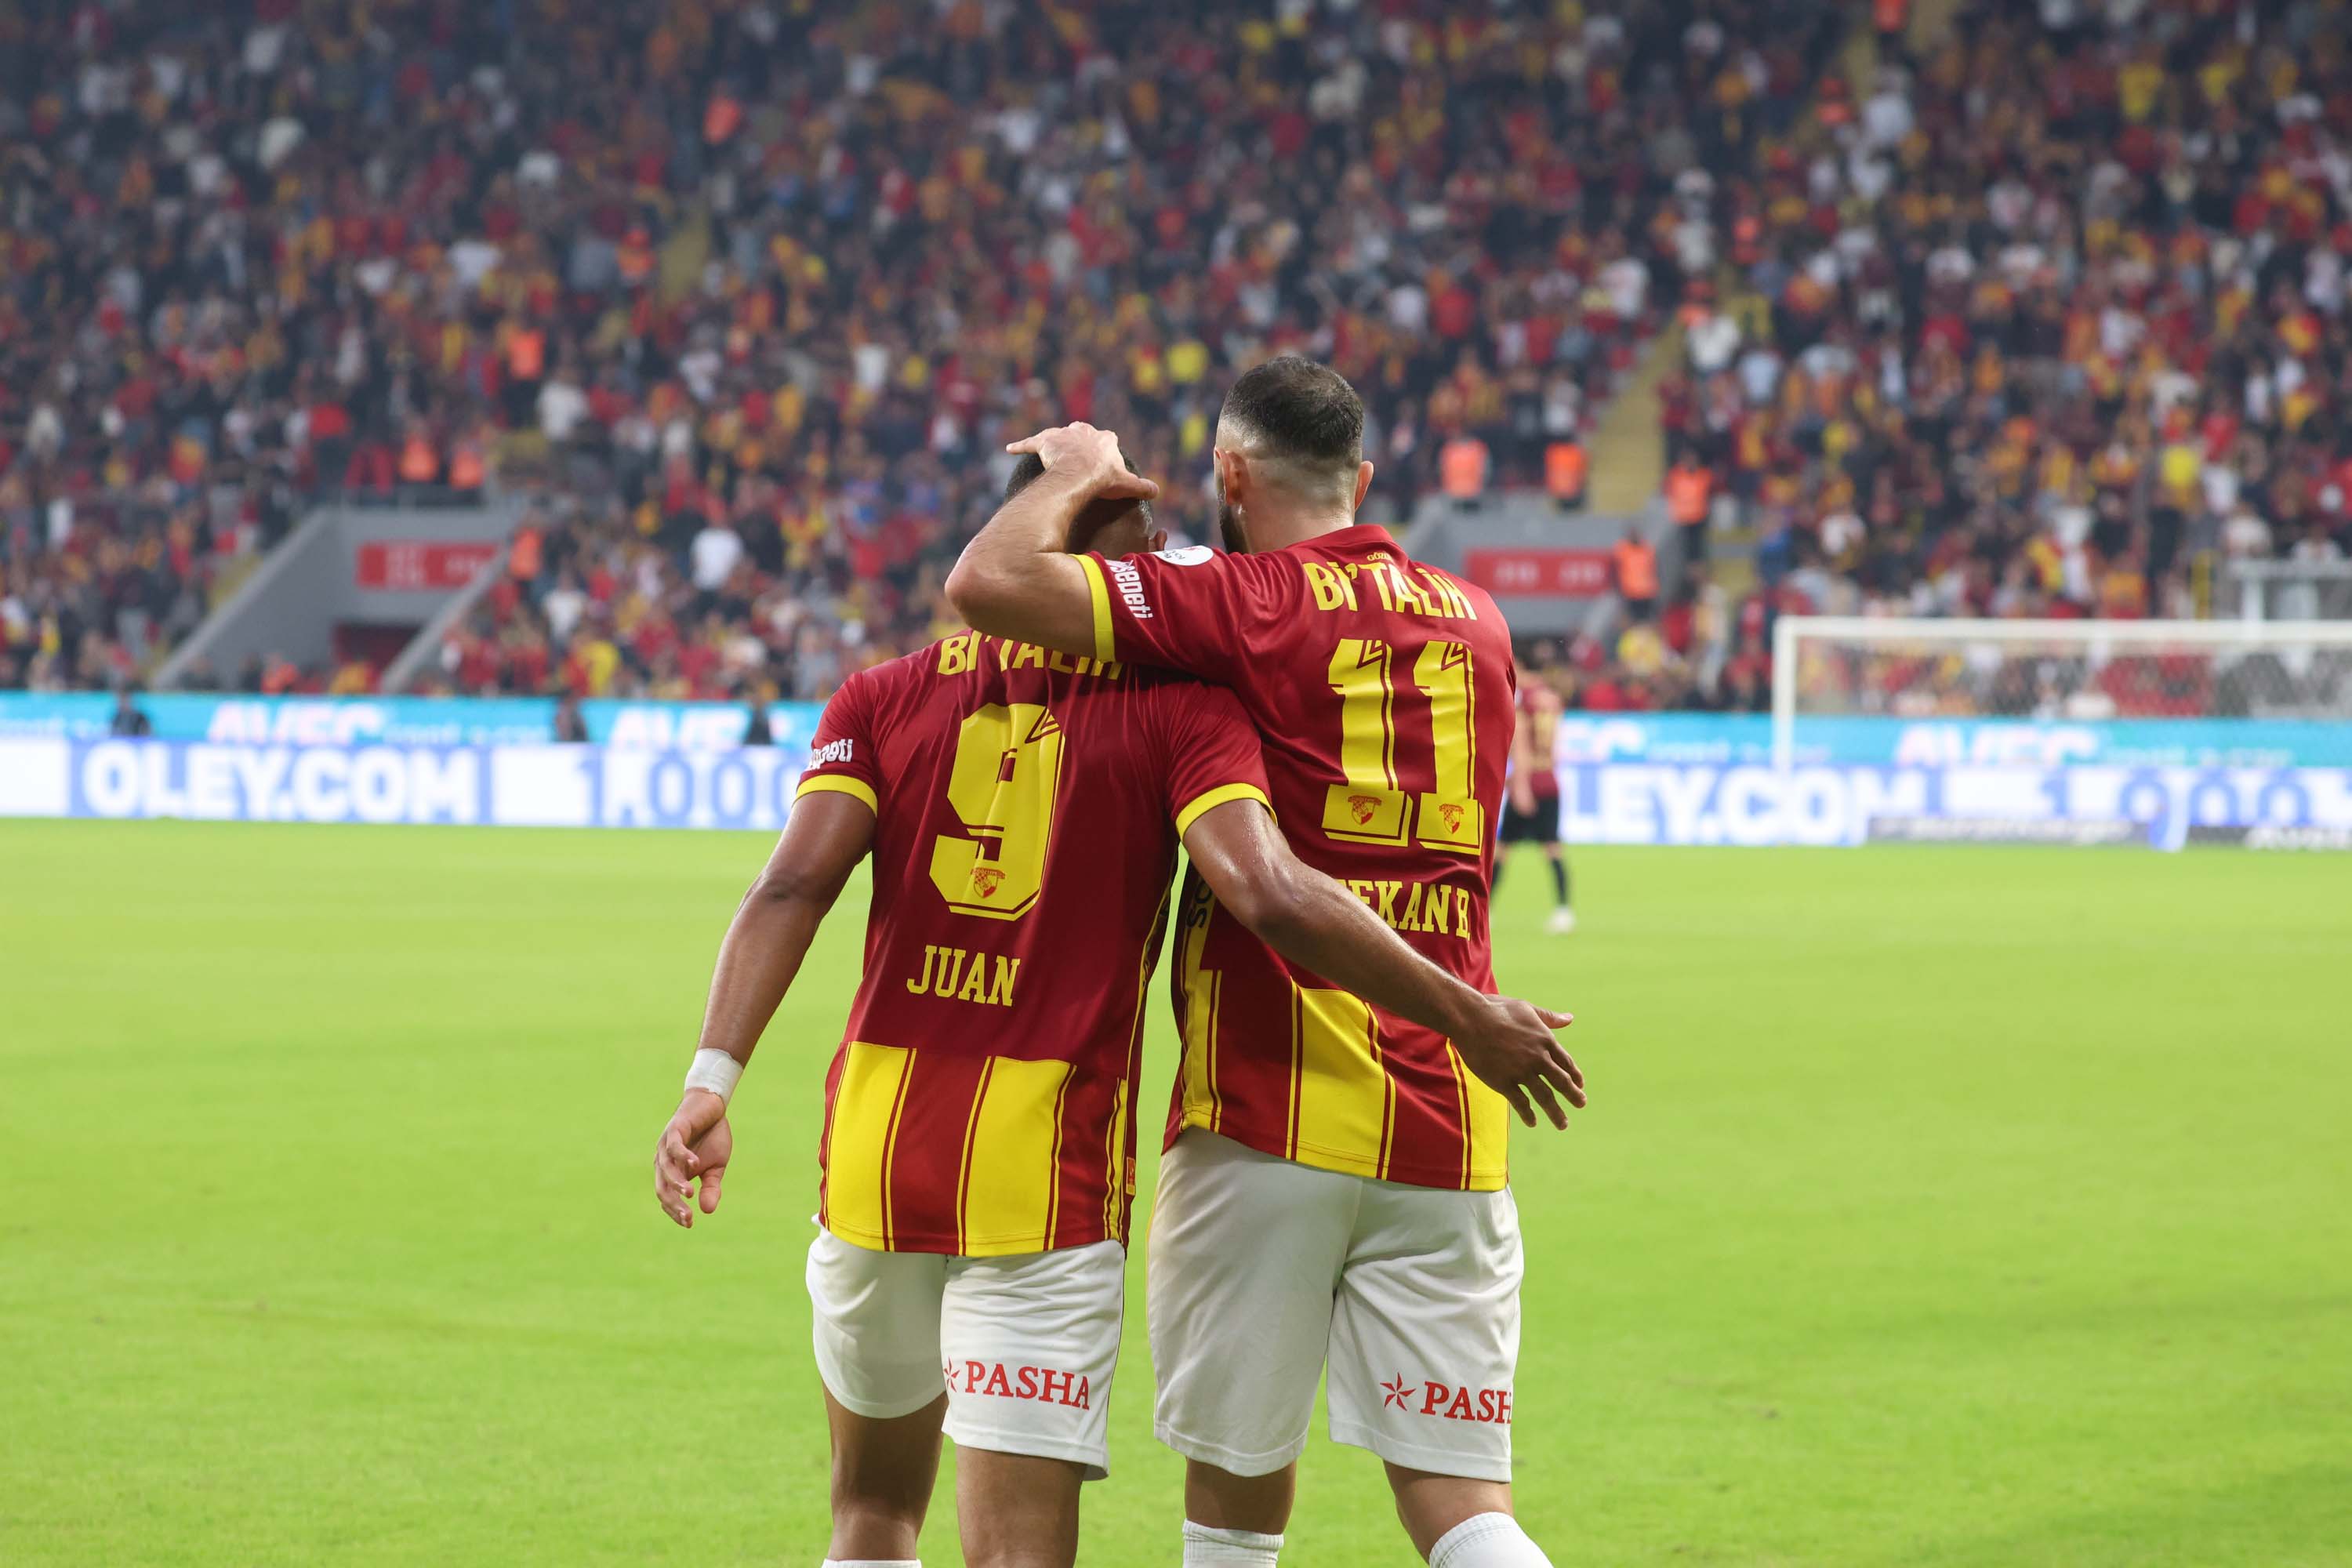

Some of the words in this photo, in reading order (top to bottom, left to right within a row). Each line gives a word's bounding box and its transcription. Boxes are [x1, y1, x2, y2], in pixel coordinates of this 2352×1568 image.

[1105, 559, 1153, 619] sepeti
[608, 707, 793, 750] AVE
[1322, 639, 1485, 855] 11
[82, 739, 477, 824] OLEY.COM
[929, 702, 1066, 921] 9
[1557, 760, 1927, 846] LEY.COM
[906, 946, 1021, 1007] JUAN
[965, 1361, 1090, 1410] PASHA
[1420, 1381, 1512, 1424] PASH
